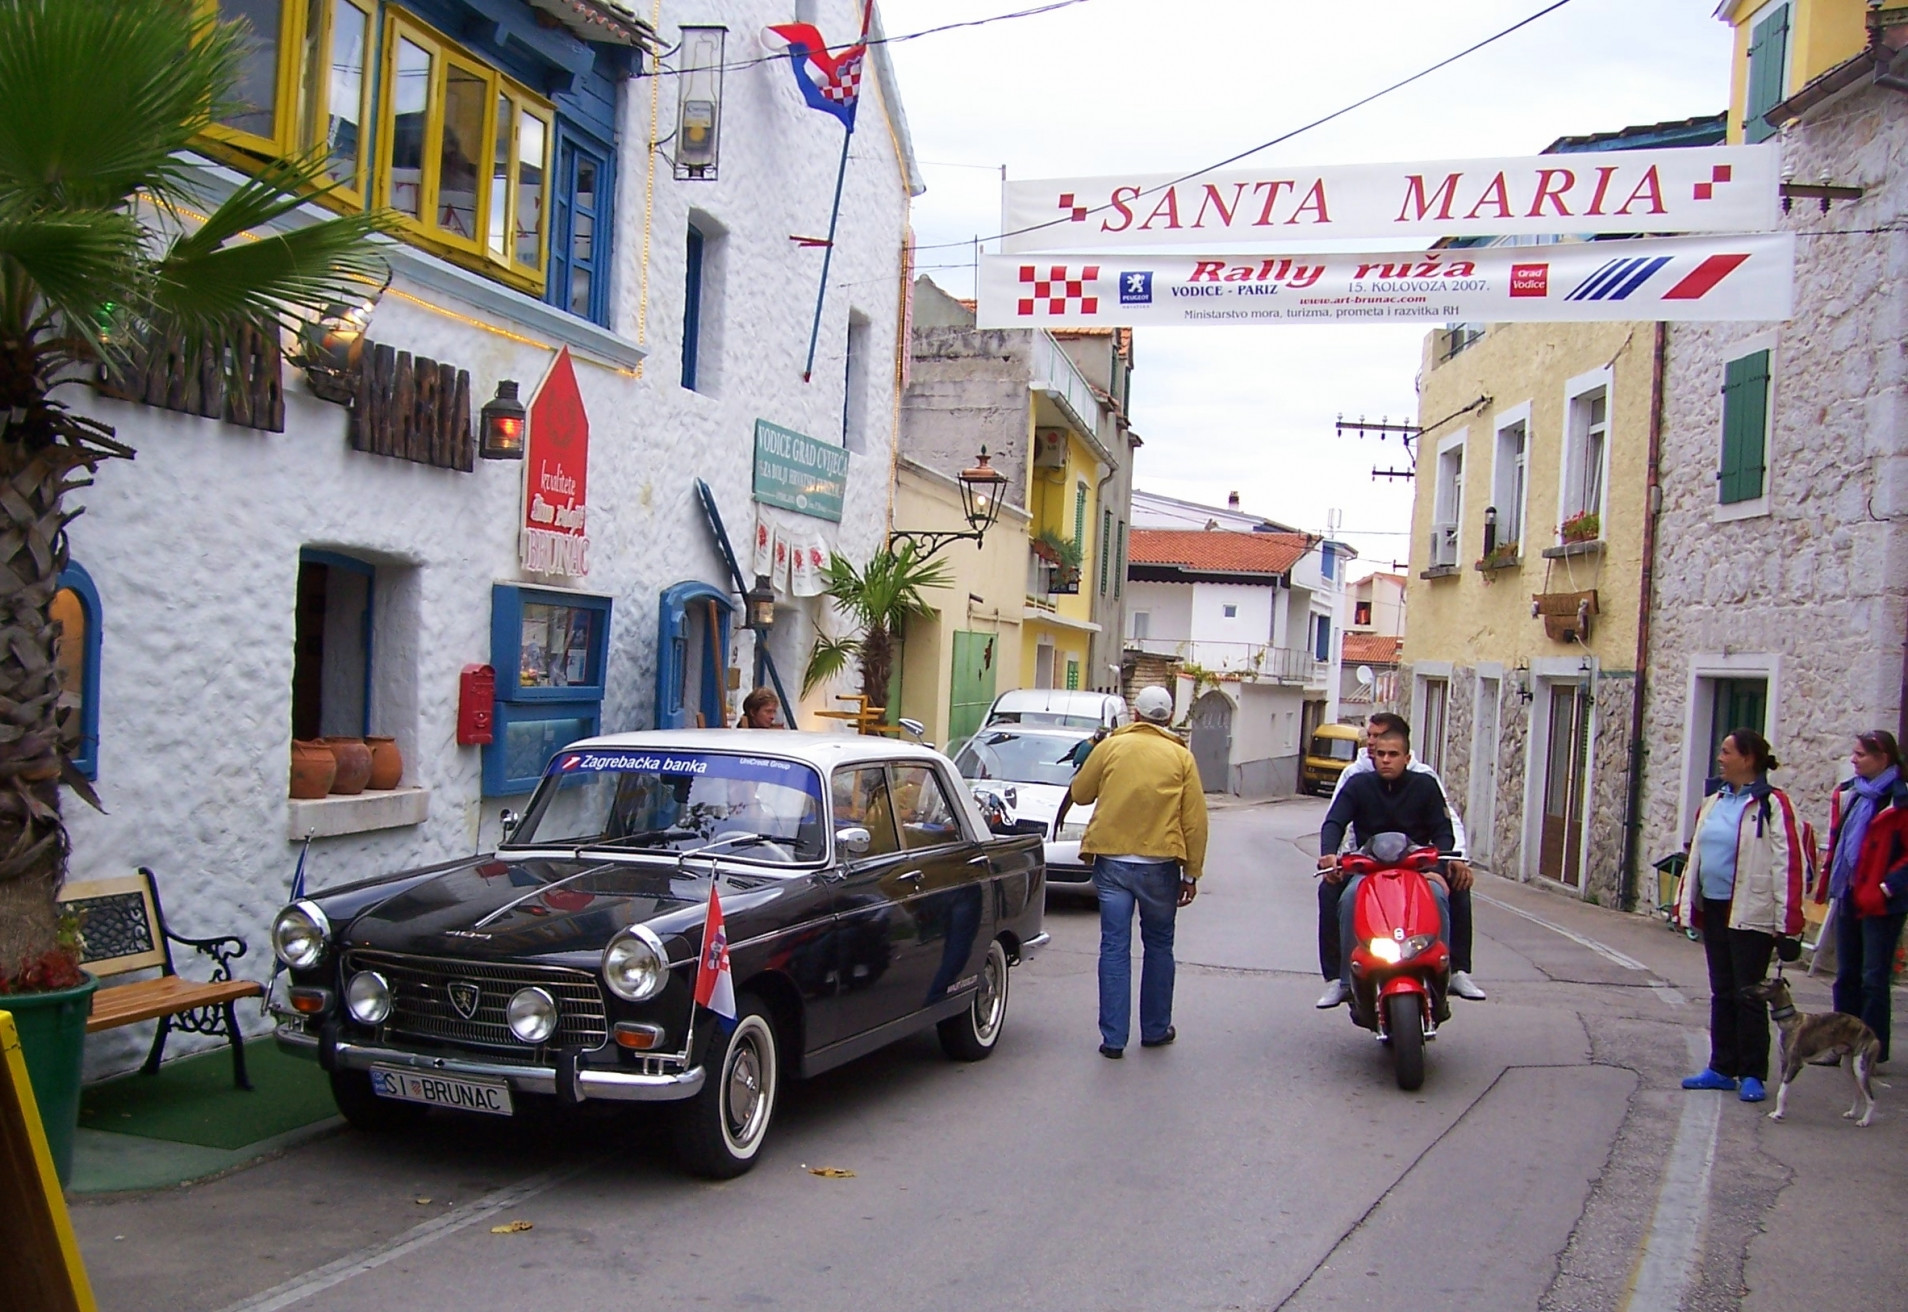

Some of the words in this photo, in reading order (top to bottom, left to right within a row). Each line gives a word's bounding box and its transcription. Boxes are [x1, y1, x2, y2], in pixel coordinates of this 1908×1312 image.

[1100, 177, 1332, 233] SANTA
[1393, 164, 1669, 222] MARIA
[1187, 258, 1326, 289] Rally
[1353, 254, 1476, 280] ruža
[1171, 285, 1224, 297] VODICE
[1237, 284, 1279, 296] PARIZ
[1349, 281, 1367, 293] 15.
[1371, 280, 1448, 292] KOLOVOZA
[1451, 279, 1491, 292] 2007.
[1513, 279, 1546, 289] Vodice
[1299, 294, 1427, 305] www.art-brunac.com
[1184, 309, 1249, 320] Ministarstvo
[1250, 310, 1284, 320] mora,
[1286, 307, 1333, 318] turizma,
[1335, 306, 1384, 318] prometa
[1393, 305, 1440, 316] razvitka
[1442, 305, 1460, 315] RH
[757, 425, 792, 458] VODICE
[792, 438, 817, 467] GRAD
[580, 754, 660, 770] Zagrebačka
[662, 757, 707, 774] banka
[770, 760, 791, 770] Group
[383, 1072, 407, 1095] SI
[421, 1079, 501, 1110] BRUNAC
